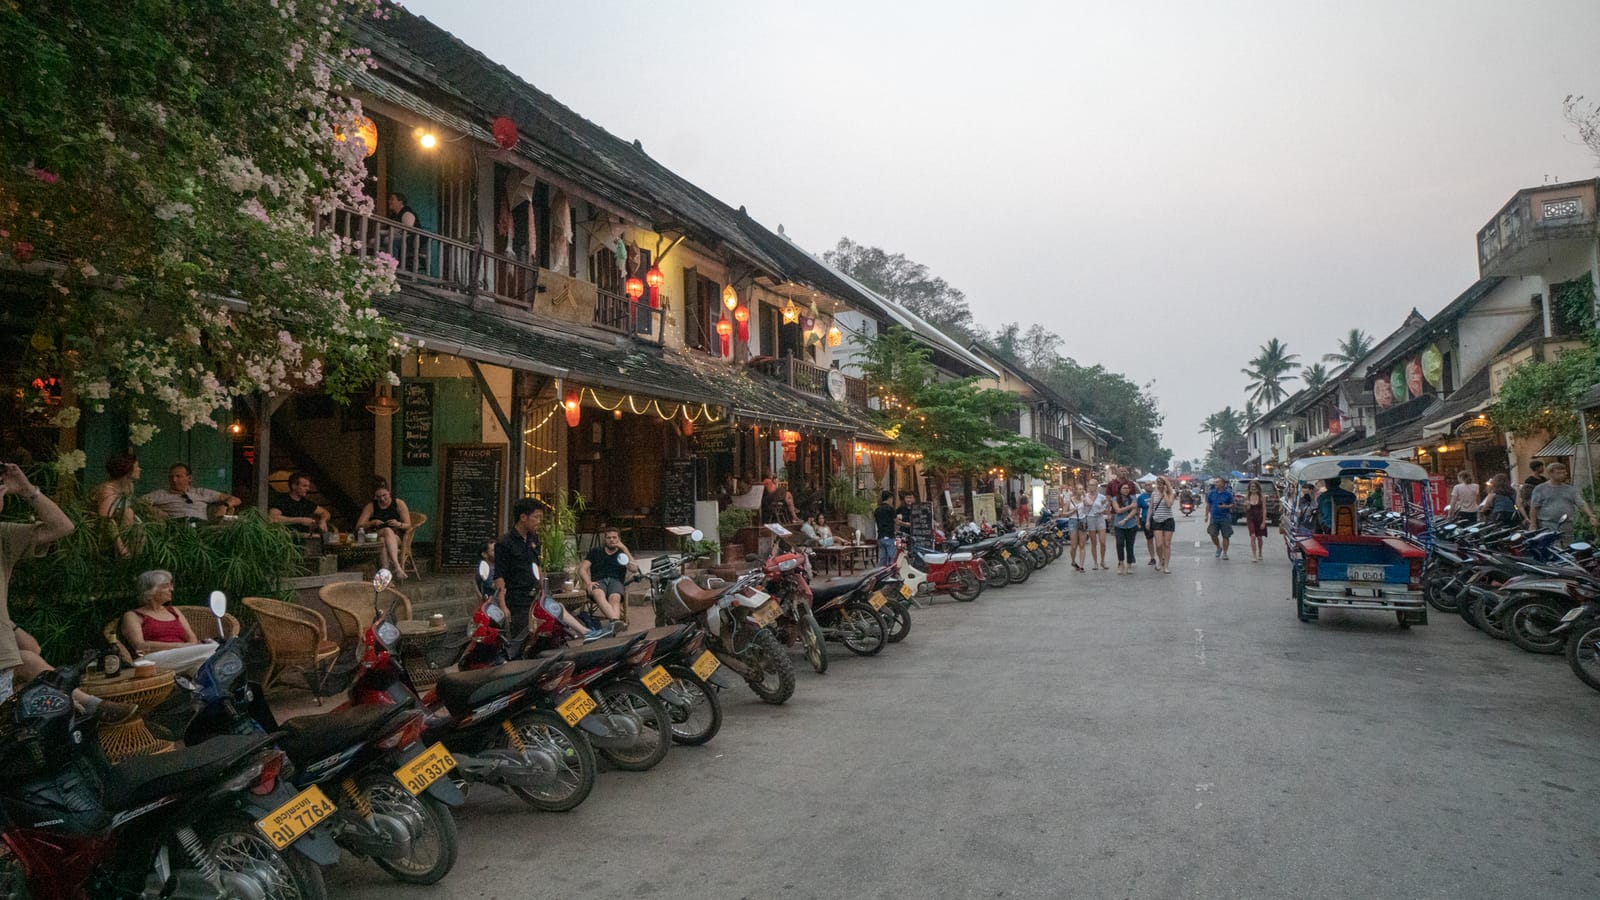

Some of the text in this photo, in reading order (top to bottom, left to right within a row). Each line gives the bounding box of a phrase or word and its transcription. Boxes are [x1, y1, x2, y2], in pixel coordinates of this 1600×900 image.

[425, 755, 454, 779] 3376
[34, 818, 64, 827] HONDA
[294, 799, 332, 829] 7764
